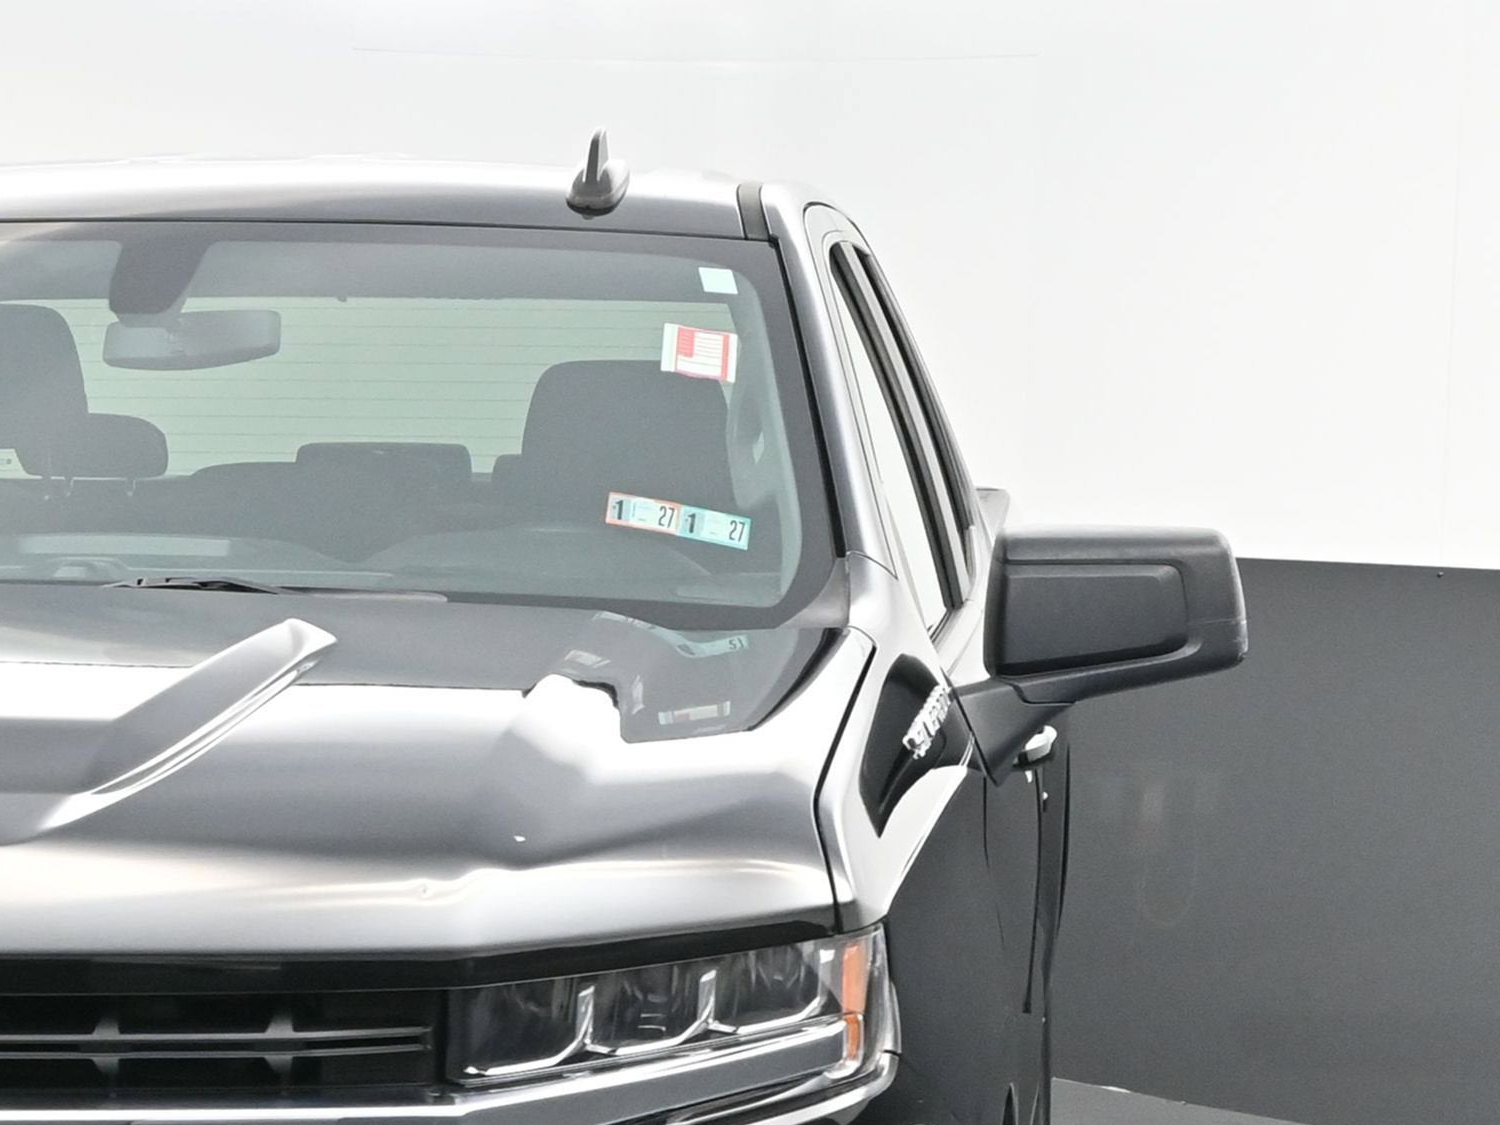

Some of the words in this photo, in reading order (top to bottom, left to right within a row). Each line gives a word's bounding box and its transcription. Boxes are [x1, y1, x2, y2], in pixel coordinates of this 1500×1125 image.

[615, 500, 624, 520] 1
[658, 505, 675, 528] 27
[687, 513, 696, 533] 1
[729, 520, 745, 542] 27
